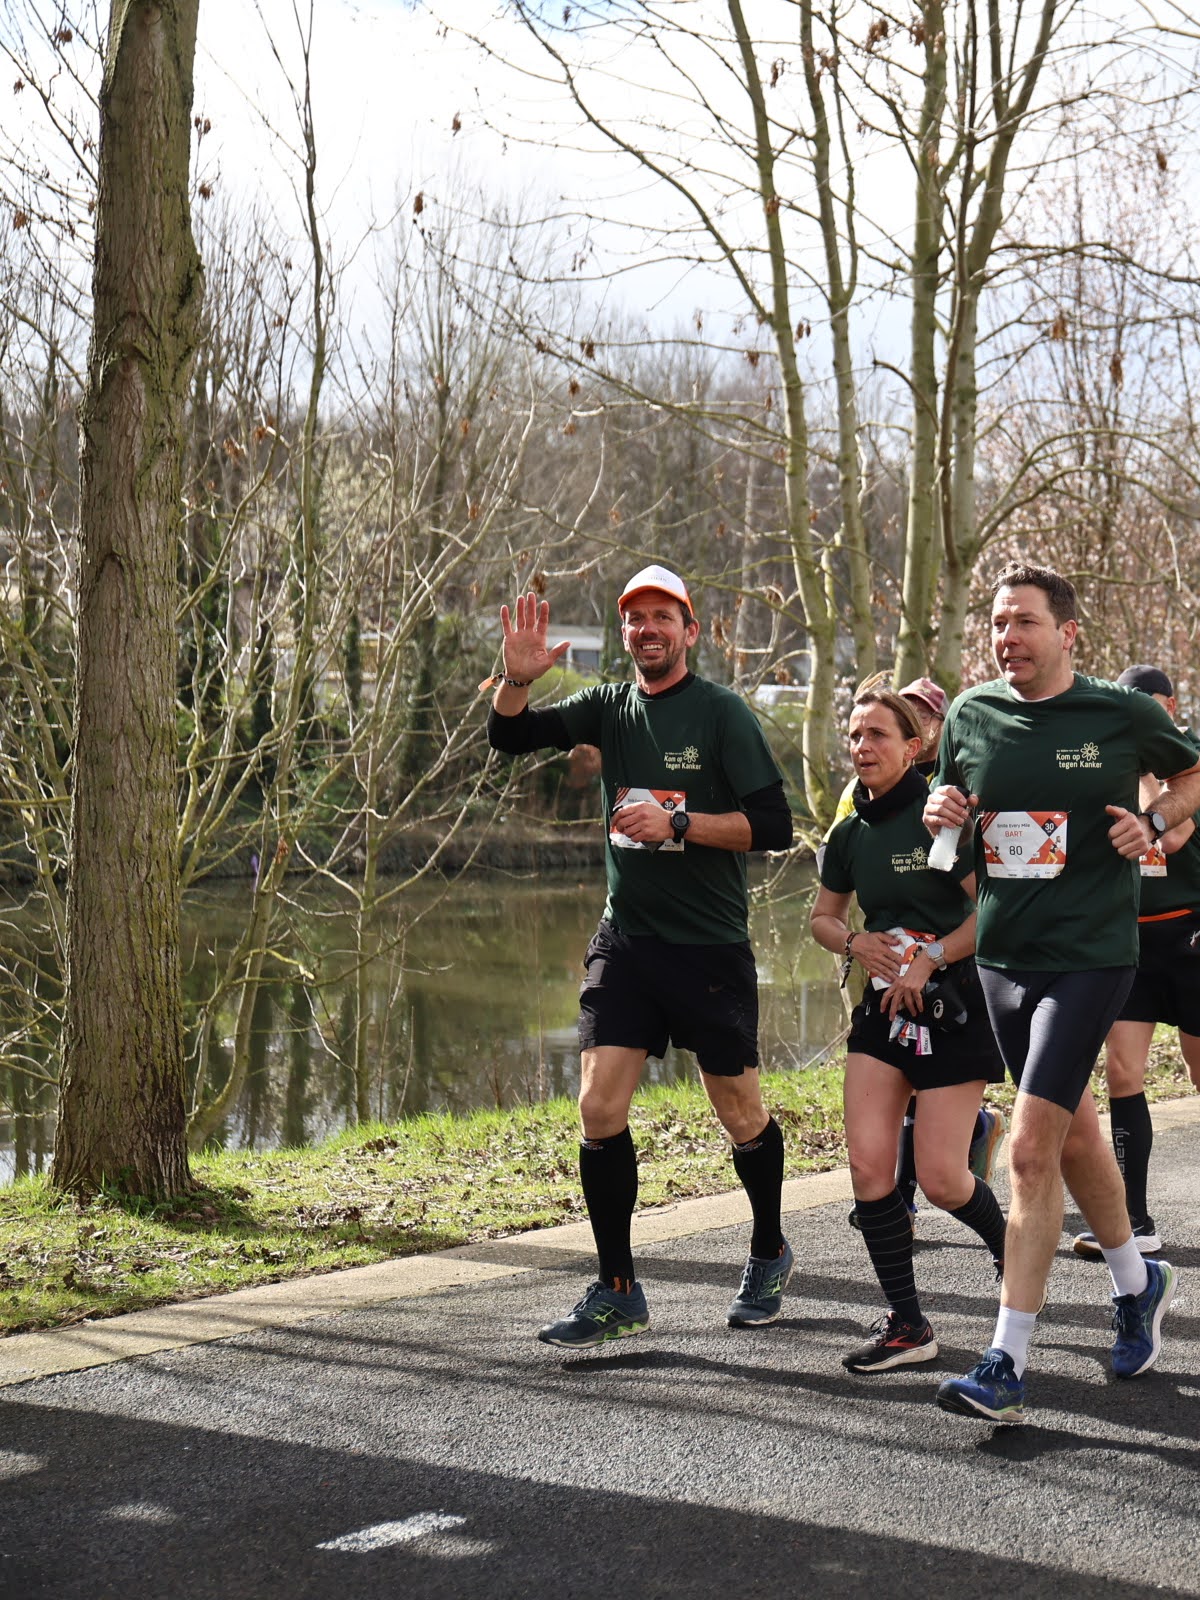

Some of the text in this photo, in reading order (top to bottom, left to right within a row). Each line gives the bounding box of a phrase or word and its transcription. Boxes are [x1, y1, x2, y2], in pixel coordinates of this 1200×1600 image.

[1072, 754, 1081, 762] op
[665, 762, 702, 770] tegen Kanker
[1059, 760, 1102, 769] tegen Kanker
[1009, 845, 1023, 856] 80
[905, 858, 912, 866] op
[894, 865, 911, 873] tegen
[1113, 1127, 1130, 1177] alenji
